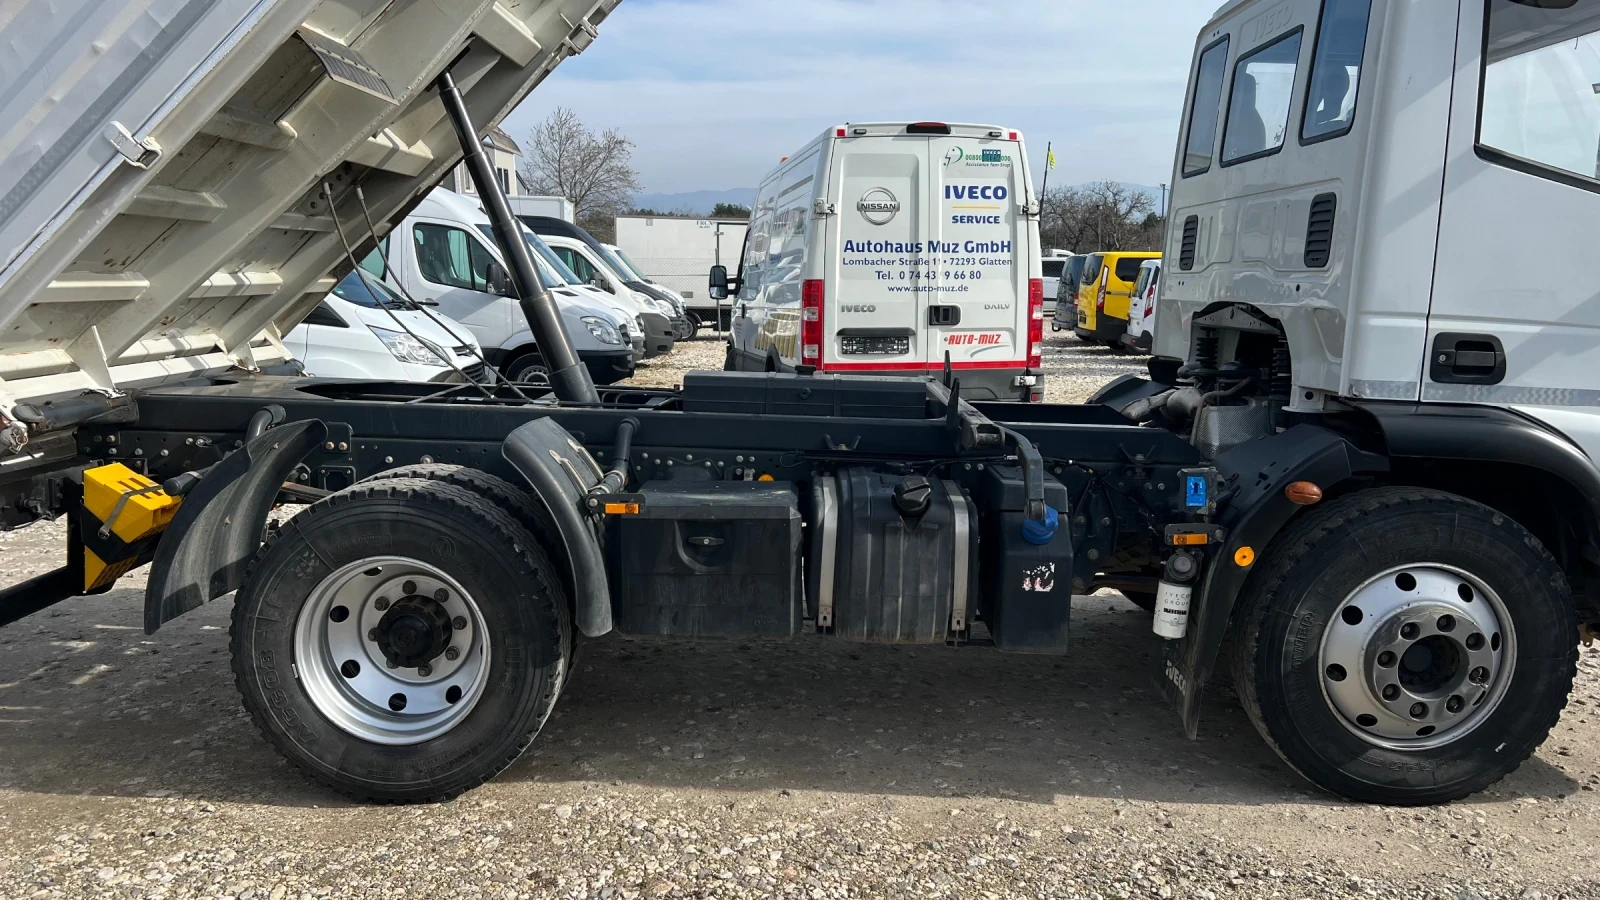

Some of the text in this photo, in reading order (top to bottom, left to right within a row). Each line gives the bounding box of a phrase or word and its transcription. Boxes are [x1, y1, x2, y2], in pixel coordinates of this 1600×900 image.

[944, 185, 1008, 200] IVECO
[951, 215, 1001, 224] SERVICE
[843, 240, 1011, 253] Autohaus Muz GmbH
[842, 257, 896, 266] Lombacher
[898, 257, 930, 266] Straße
[949, 257, 976, 266] 72293
[978, 257, 1013, 266] Glatten
[874, 270, 982, 280] Tel. 0 74 43 9 66 80
[887, 284, 969, 293] www.auto-muz.de
[841, 304, 877, 313] IVECO
[947, 334, 1002, 345] AUTO-MUZ
[1165, 591, 1190, 599] IVECO
[1164, 598, 1189, 607] GROUP
